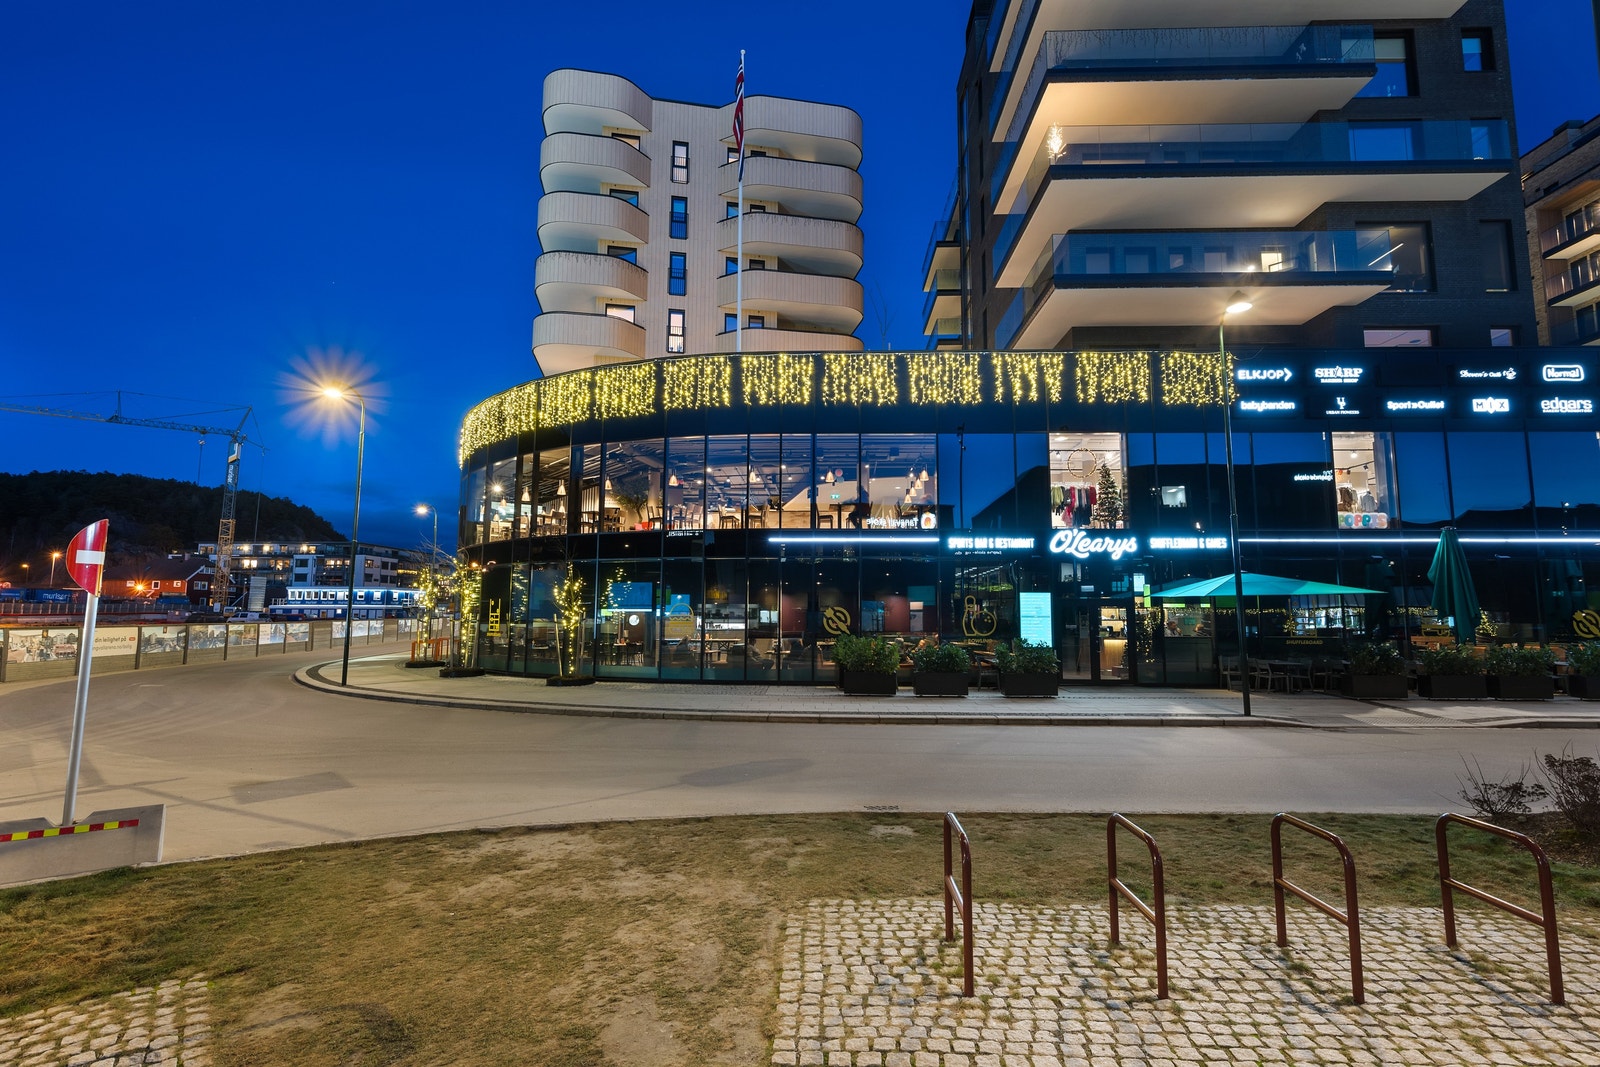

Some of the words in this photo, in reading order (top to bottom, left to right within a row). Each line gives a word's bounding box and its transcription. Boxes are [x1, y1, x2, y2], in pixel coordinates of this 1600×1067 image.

[1314, 366, 1363, 378] SHARP
[1547, 367, 1580, 378] Normal
[1541, 397, 1593, 413] edgars
[948, 537, 974, 549] SPORTS
[1049, 529, 1138, 560] O'Learys
